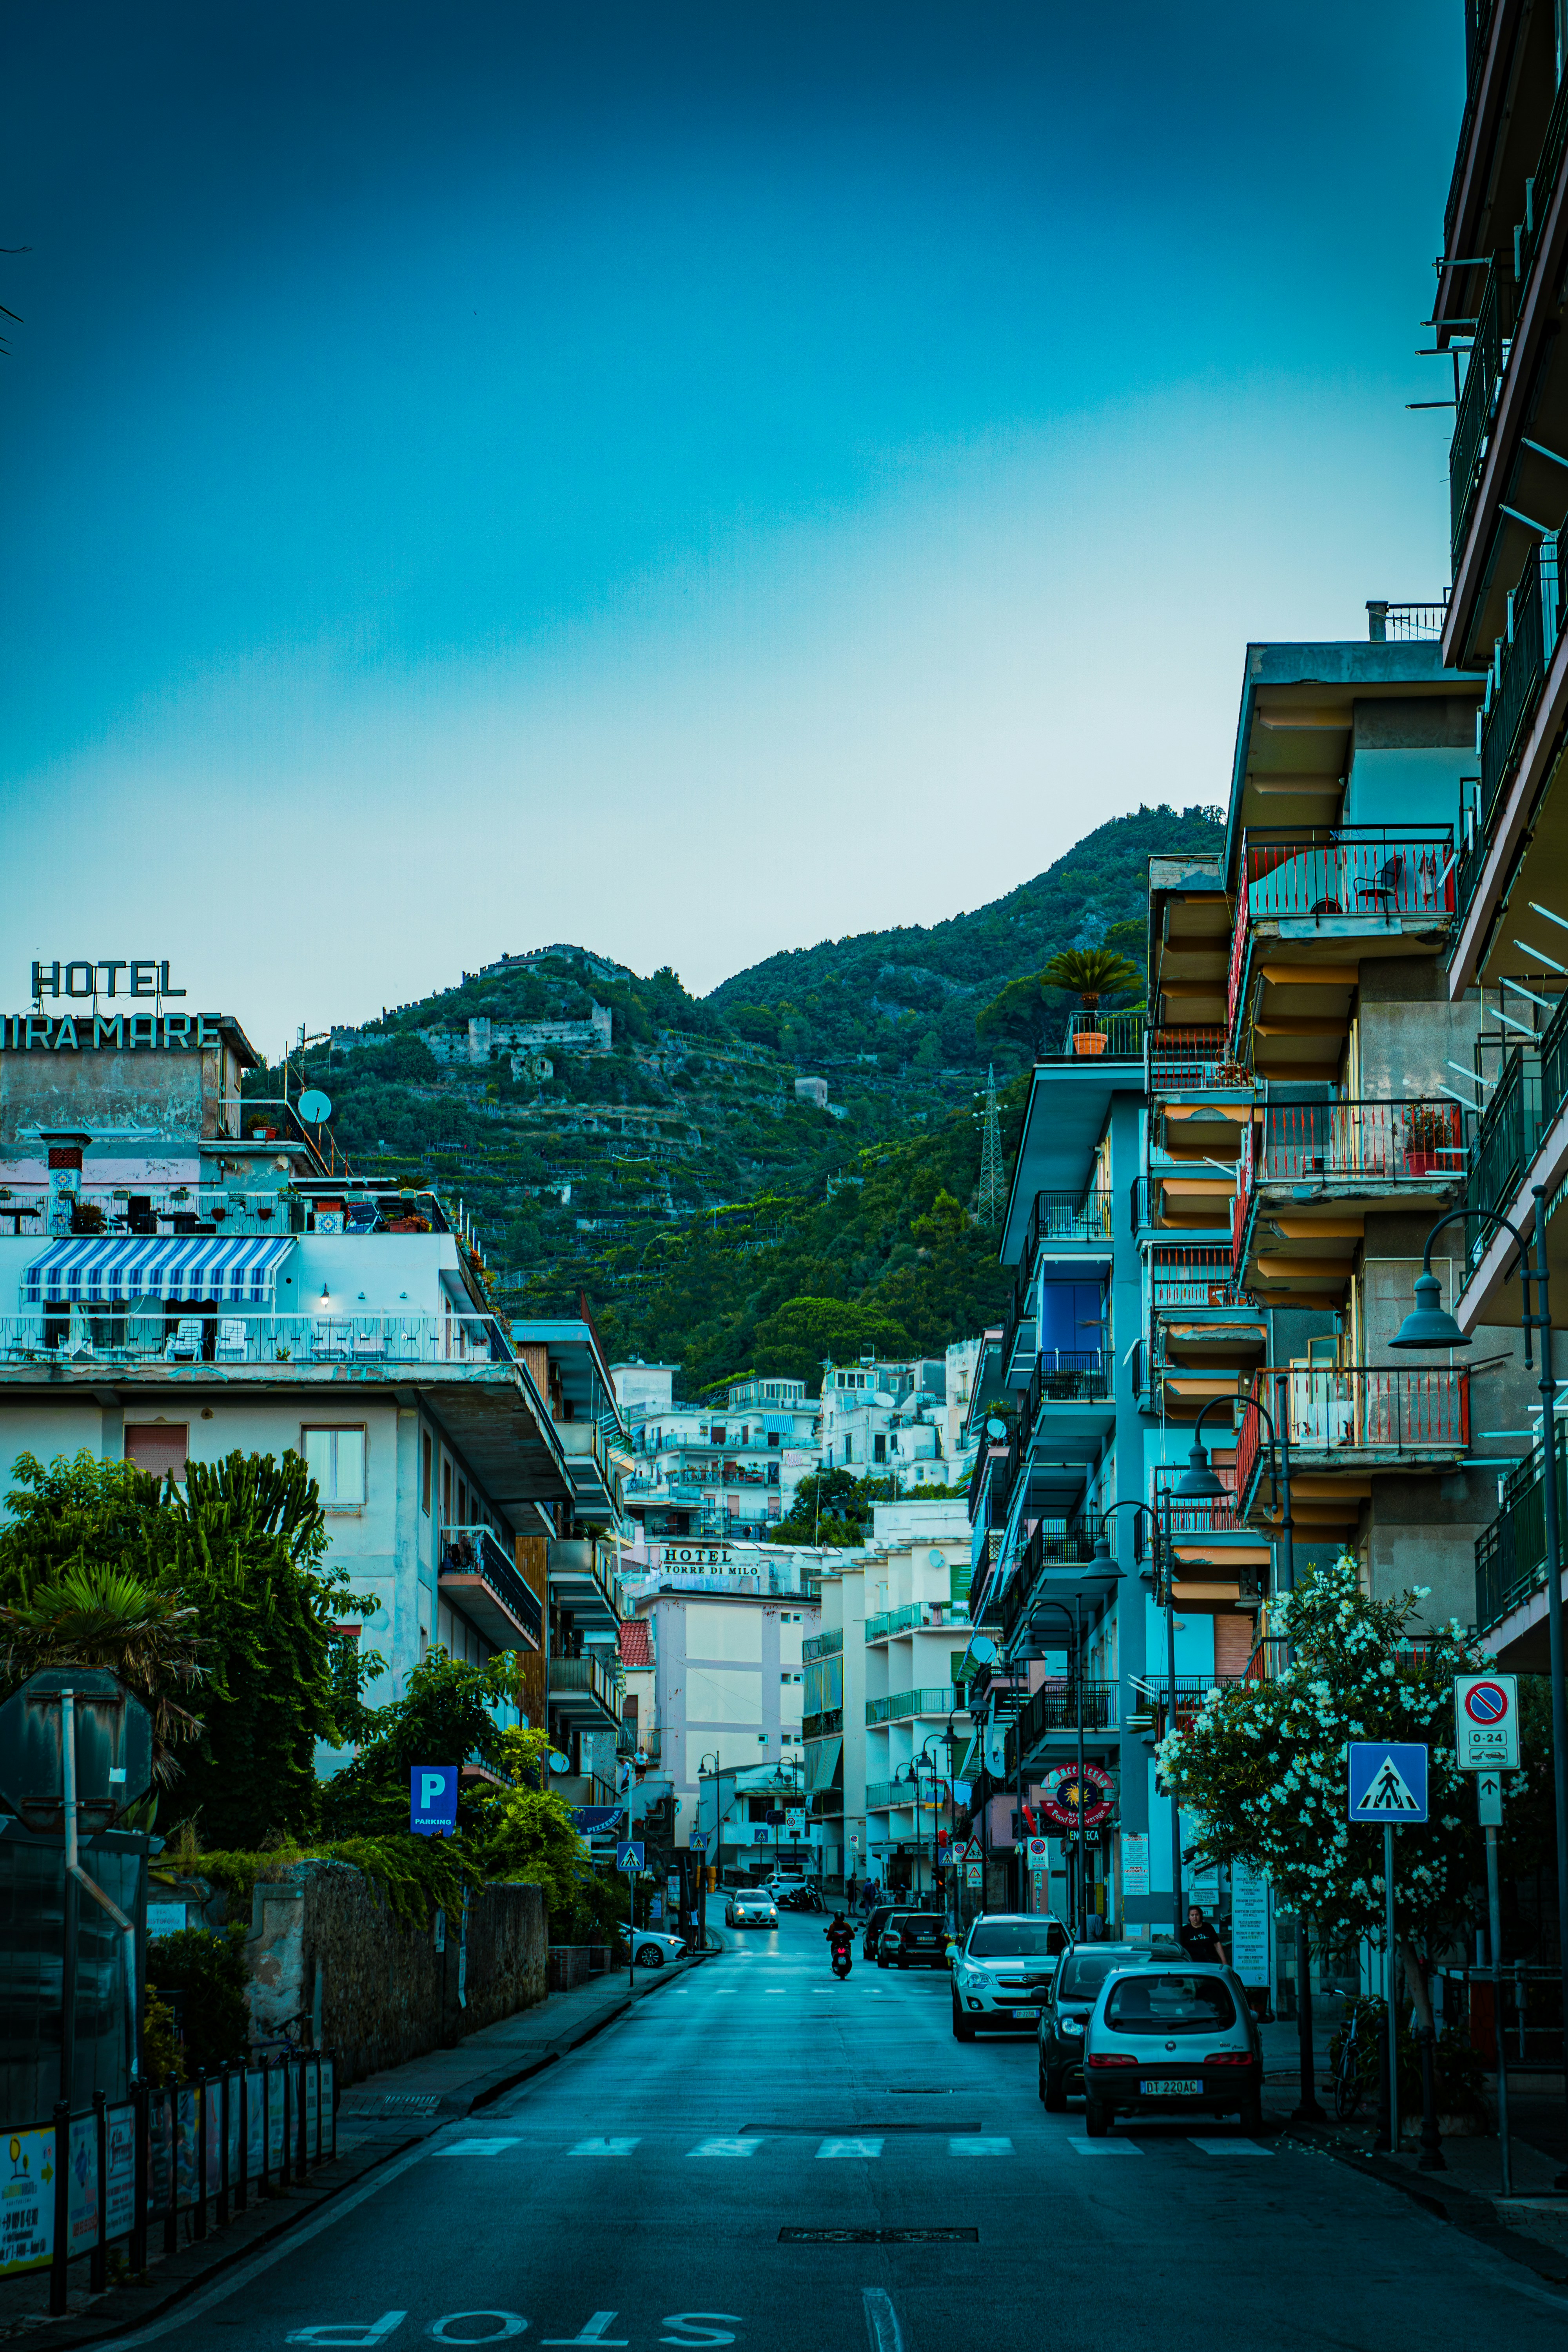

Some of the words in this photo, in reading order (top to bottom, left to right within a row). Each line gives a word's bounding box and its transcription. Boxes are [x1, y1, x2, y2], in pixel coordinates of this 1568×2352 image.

[32, 960, 187, 998] HOTEL
[93, 1013, 221, 1049] MARE
[664, 1549, 732, 1562] HOTEL
[665, 1566, 705, 1574] TORRE
[710, 1566, 723, 1574] DI
[728, 1567, 758, 1575] MILO
[421, 1773, 445, 1809] P
[587, 1810, 621, 1833] PIZZERIA
[1051, 1809, 1068, 1823] Food
[1077, 1810, 1105, 1825] verage
[1147, 2082, 1160, 2093] DT
[1164, 2081, 1196, 2093] 220AC
[285, 2310, 746, 2347] STOP
